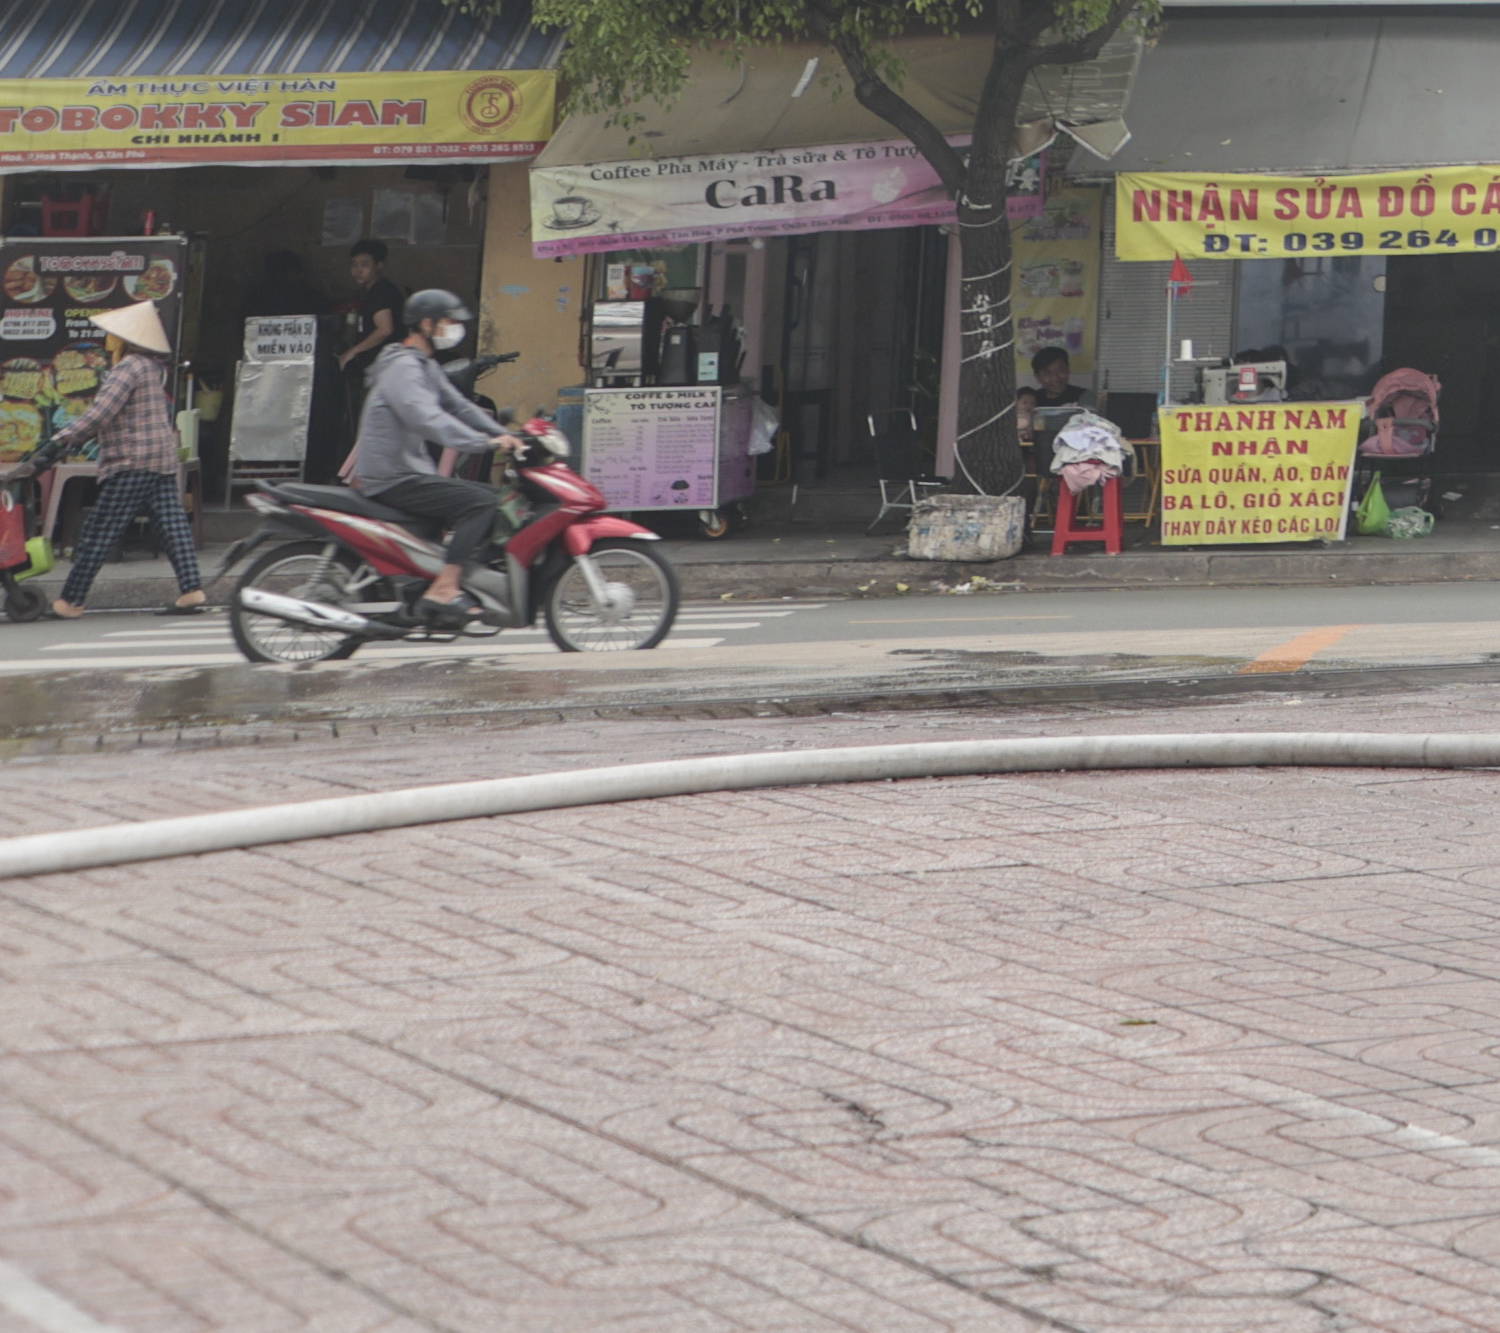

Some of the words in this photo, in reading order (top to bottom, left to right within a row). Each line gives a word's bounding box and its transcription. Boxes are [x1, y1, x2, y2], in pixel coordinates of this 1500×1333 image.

[87, 80, 128, 96] ẨM
[135, 80, 210, 97] THỰC
[217, 77, 272, 96] VIỆT
[279, 77, 336, 93] HÀN
[0, 100, 269, 134] TOBOKKY
[279, 99, 427, 129] SIAM
[131, 135, 170, 145] CHI
[178, 133, 261, 144] NHÁNH
[590, 164, 651, 182] Coffee
[657, 160, 692, 176] Pha
[698, 156, 739, 174] Máy
[754, 154, 788, 168] Trà
[833, 149, 848, 162] &
[881, 144, 922, 161] Tượ
[705, 173, 838, 210] CaRa
[1132, 182, 1259, 229] NHẬN
[1274, 177, 1364, 221] SỬA
[1377, 173, 1436, 218] ĐỒ
[1203, 233, 1268, 253] ĐT:
[1284, 231, 1364, 252] 039
[1379, 229, 1459, 250] 264
[1175, 409, 1276, 432] THANH
[1284, 408, 1347, 431] NAM
[1211, 437, 1309, 458] NHẬN
[1164, 463, 1202, 484] SỬA
[1208, 462, 1267, 485] QUẦN,
[1273, 464, 1304, 482] ÁO,
[1164, 495, 1194, 510] BA
[1201, 490, 1235, 510] LÔ,
[1243, 488, 1281, 509] GIỎ
[1241, 515, 1273, 534] KÉO
[1278, 514, 1310, 534] CÁC
